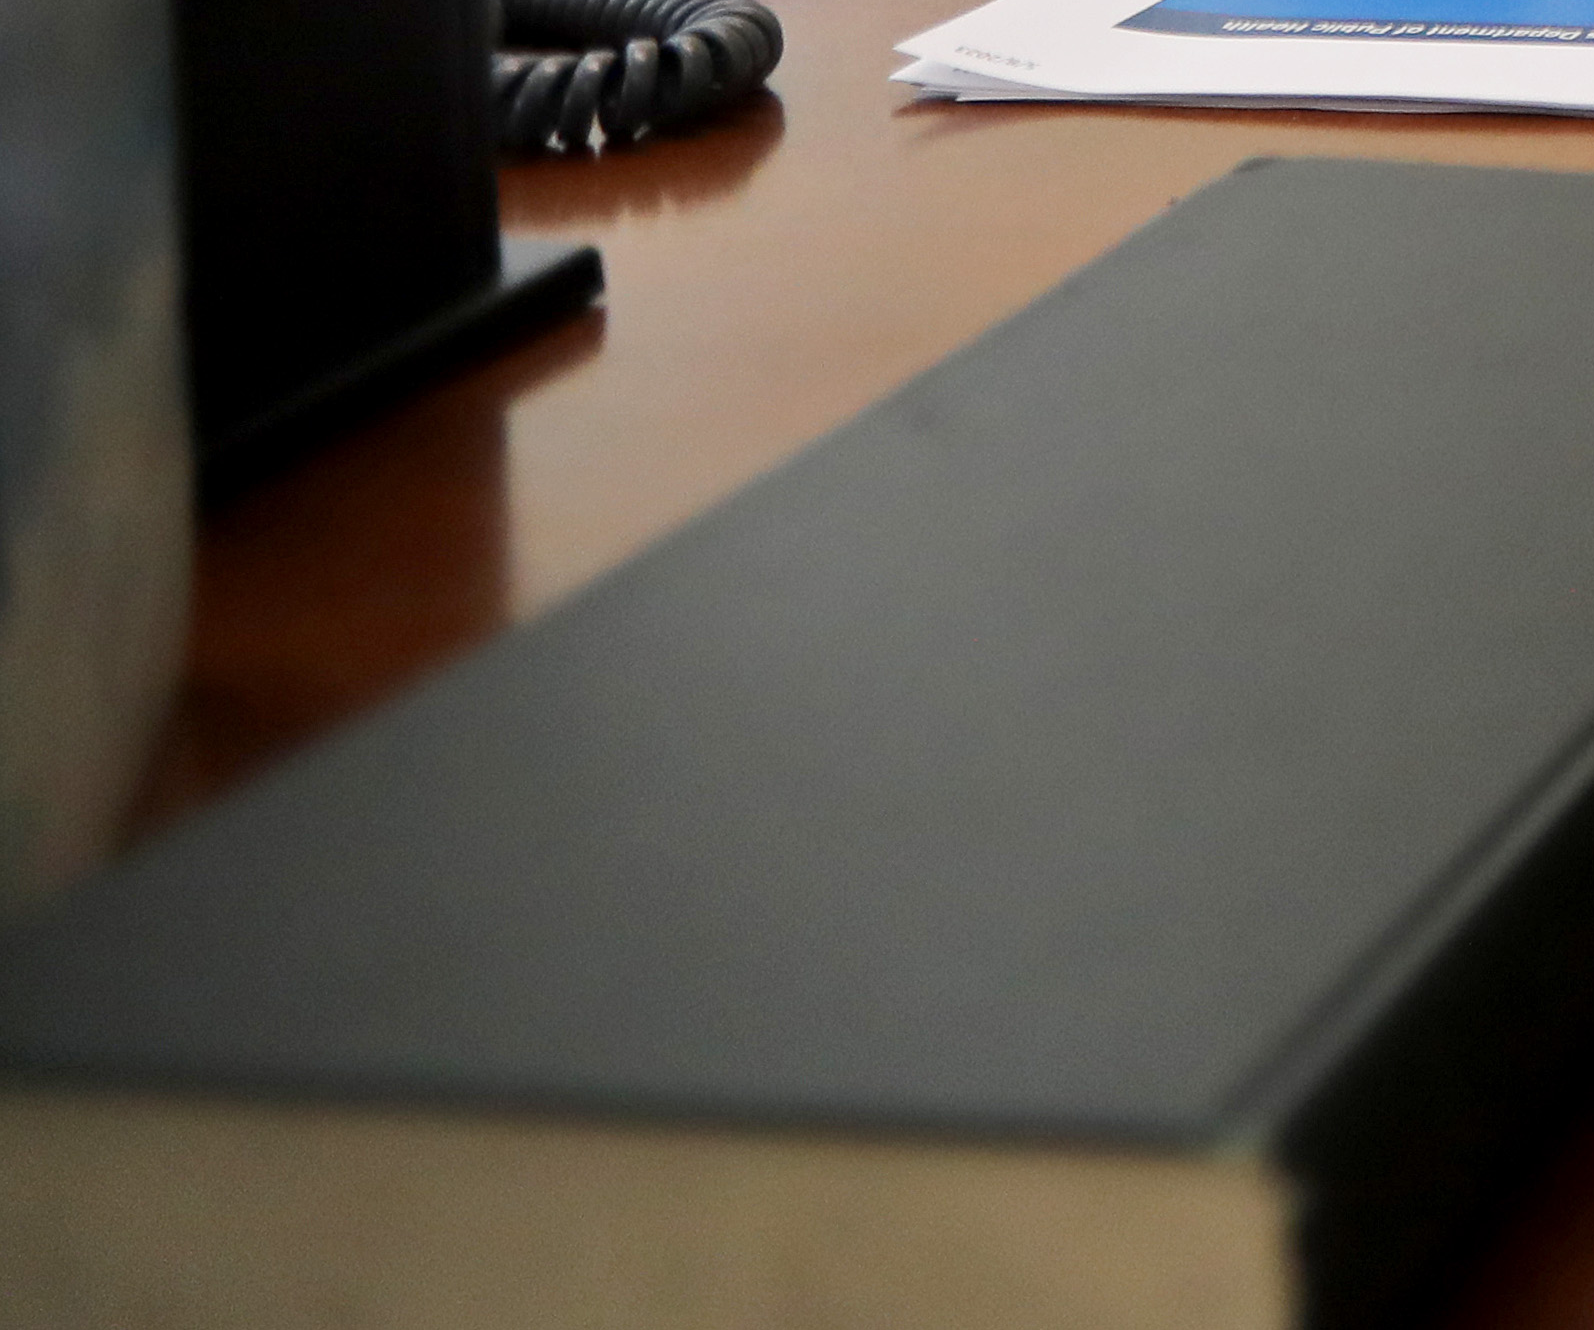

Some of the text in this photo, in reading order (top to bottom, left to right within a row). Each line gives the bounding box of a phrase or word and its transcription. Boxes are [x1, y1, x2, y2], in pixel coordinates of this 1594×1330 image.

[1222, 18, 1308, 33] Health
[1312, 20, 1392, 36] Public
[1392, 22, 1422, 37] of
[1426, 24, 1585, 41] Department
